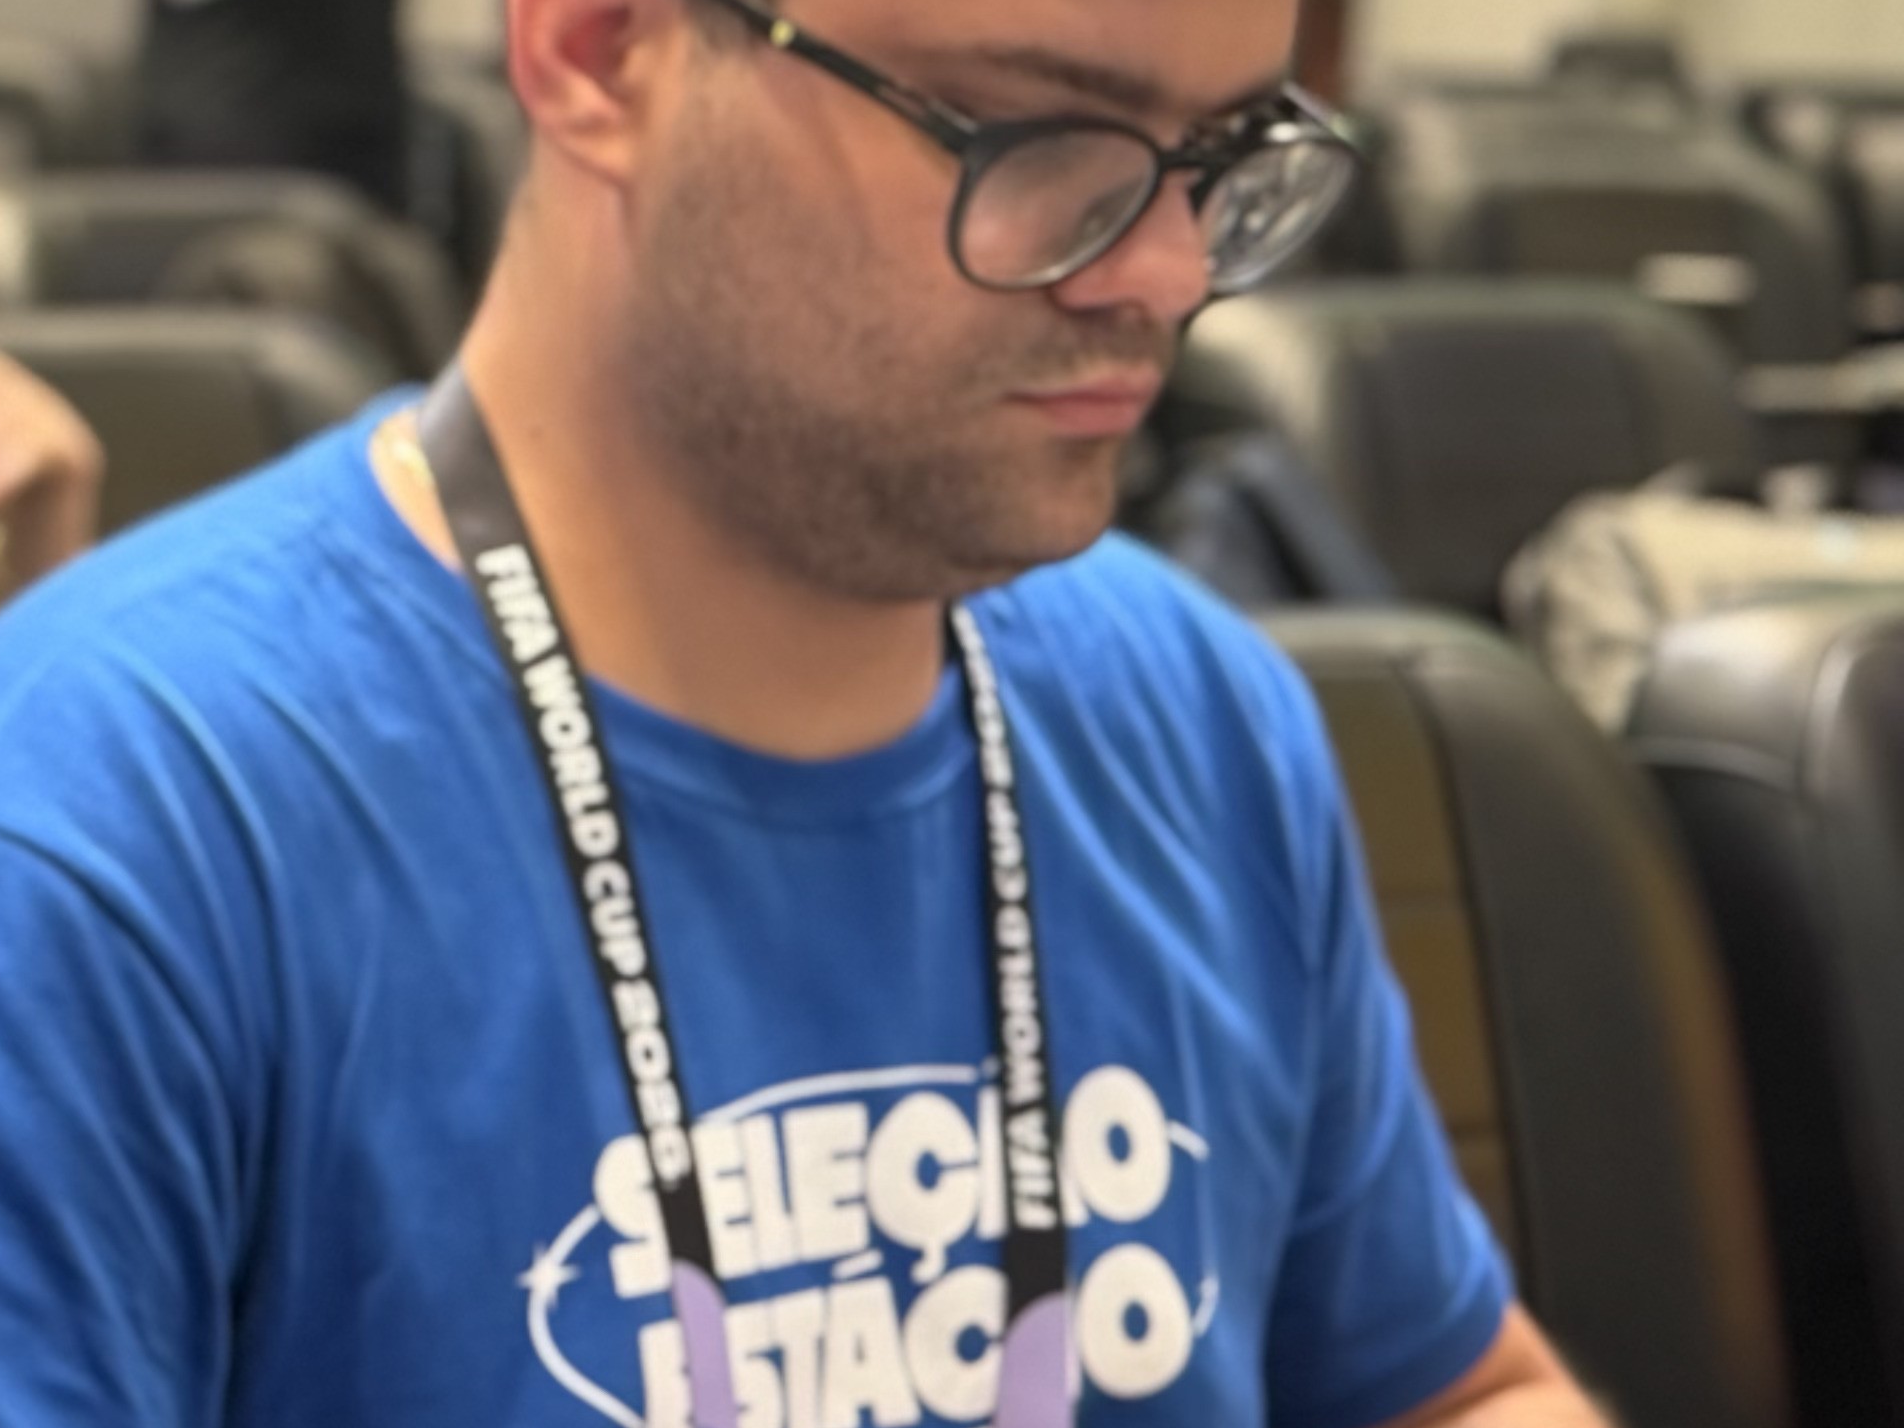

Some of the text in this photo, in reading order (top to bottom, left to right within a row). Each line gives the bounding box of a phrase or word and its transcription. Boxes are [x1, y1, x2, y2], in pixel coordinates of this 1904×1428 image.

[475, 543, 558, 663] FIFA
[522, 655, 620, 858] WORLD
[583, 860, 648, 977] CUP
